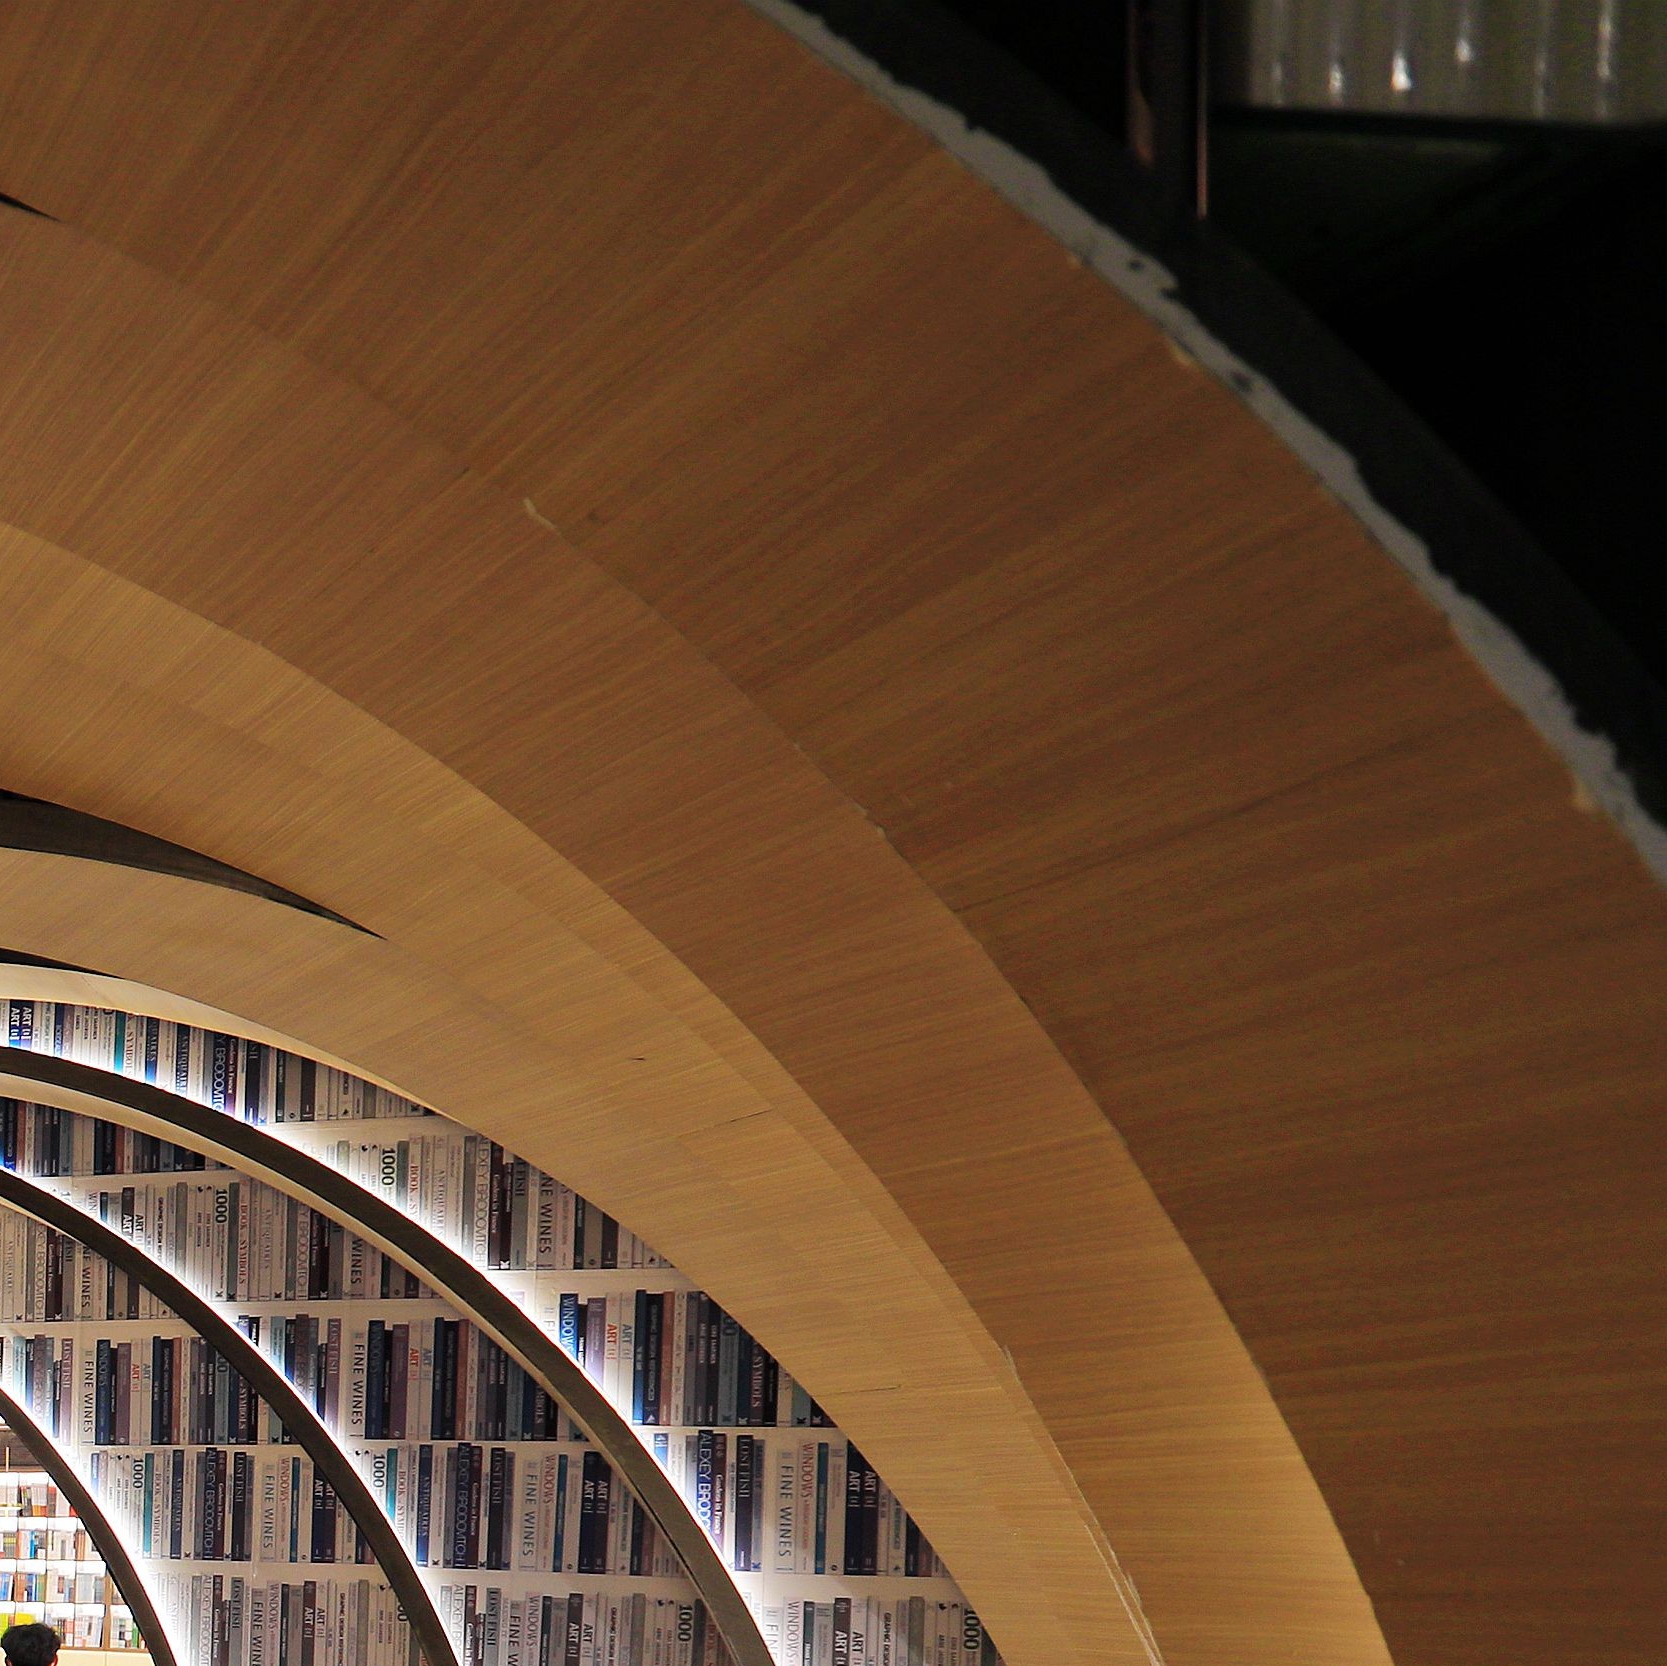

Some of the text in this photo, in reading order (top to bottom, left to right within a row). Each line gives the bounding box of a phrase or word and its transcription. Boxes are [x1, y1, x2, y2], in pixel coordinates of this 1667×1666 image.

[380, 1148, 395, 1186] 1000
[81, 1264, 91, 1309] WINES
[351, 1343, 365, 1426] FINE WINES
[262, 1474, 275, 1549] FINE WINES
[253, 1601, 264, 1631] FINE
